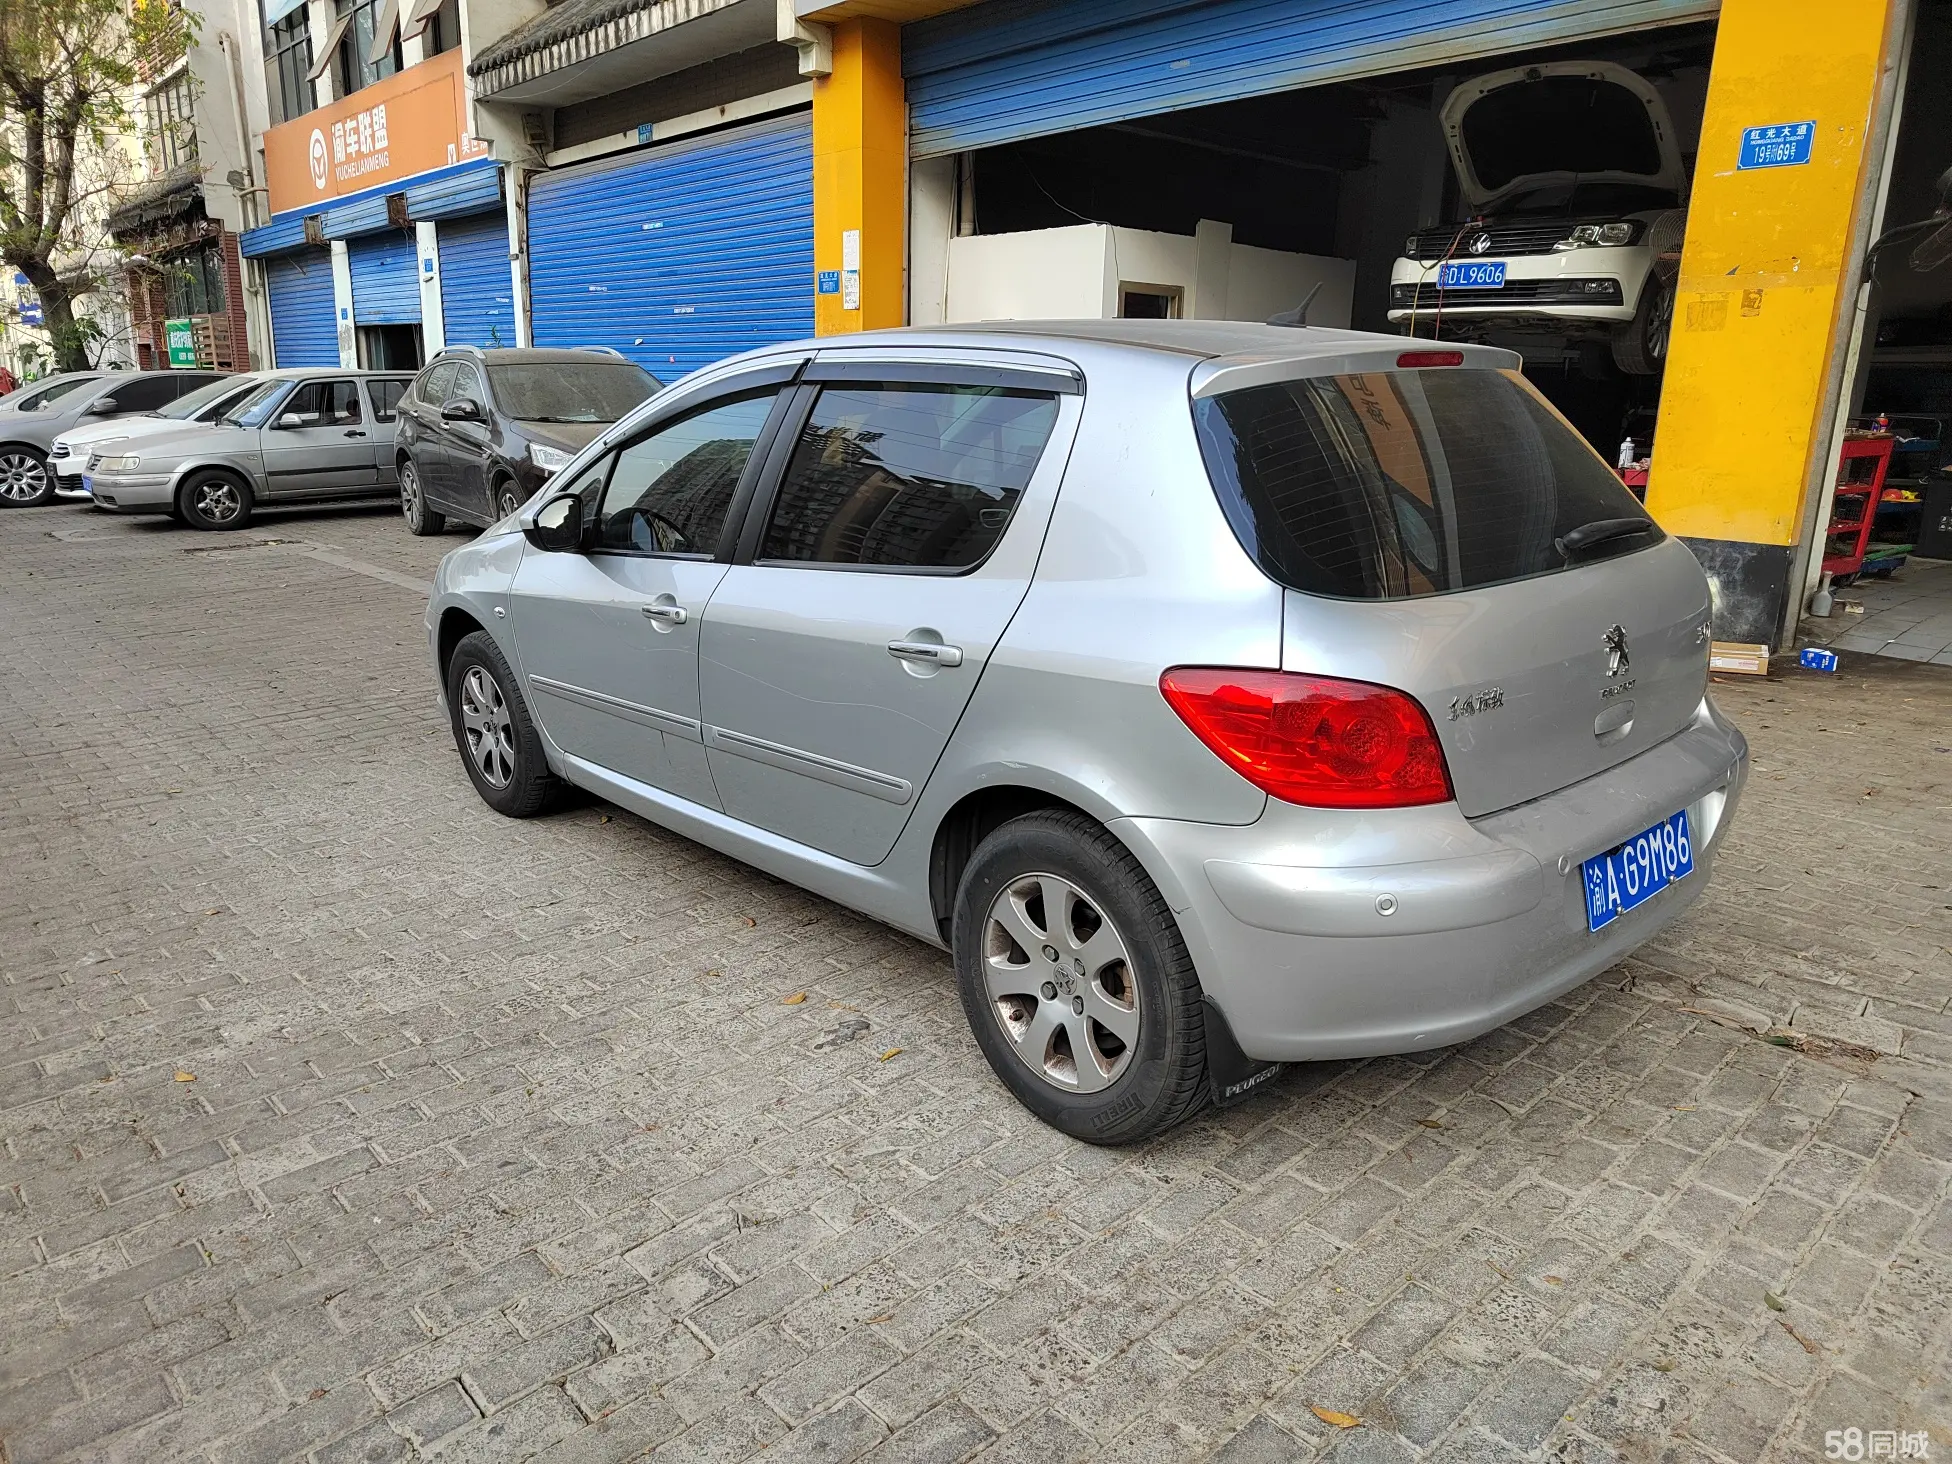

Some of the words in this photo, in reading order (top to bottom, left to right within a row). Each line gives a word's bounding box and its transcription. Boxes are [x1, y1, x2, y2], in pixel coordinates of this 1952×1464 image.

[332, 104, 388, 164] 渝车联盟
[1750, 124, 1808, 139] 红光大道
[335, 151, 390, 182] YUCHELIANMENG
